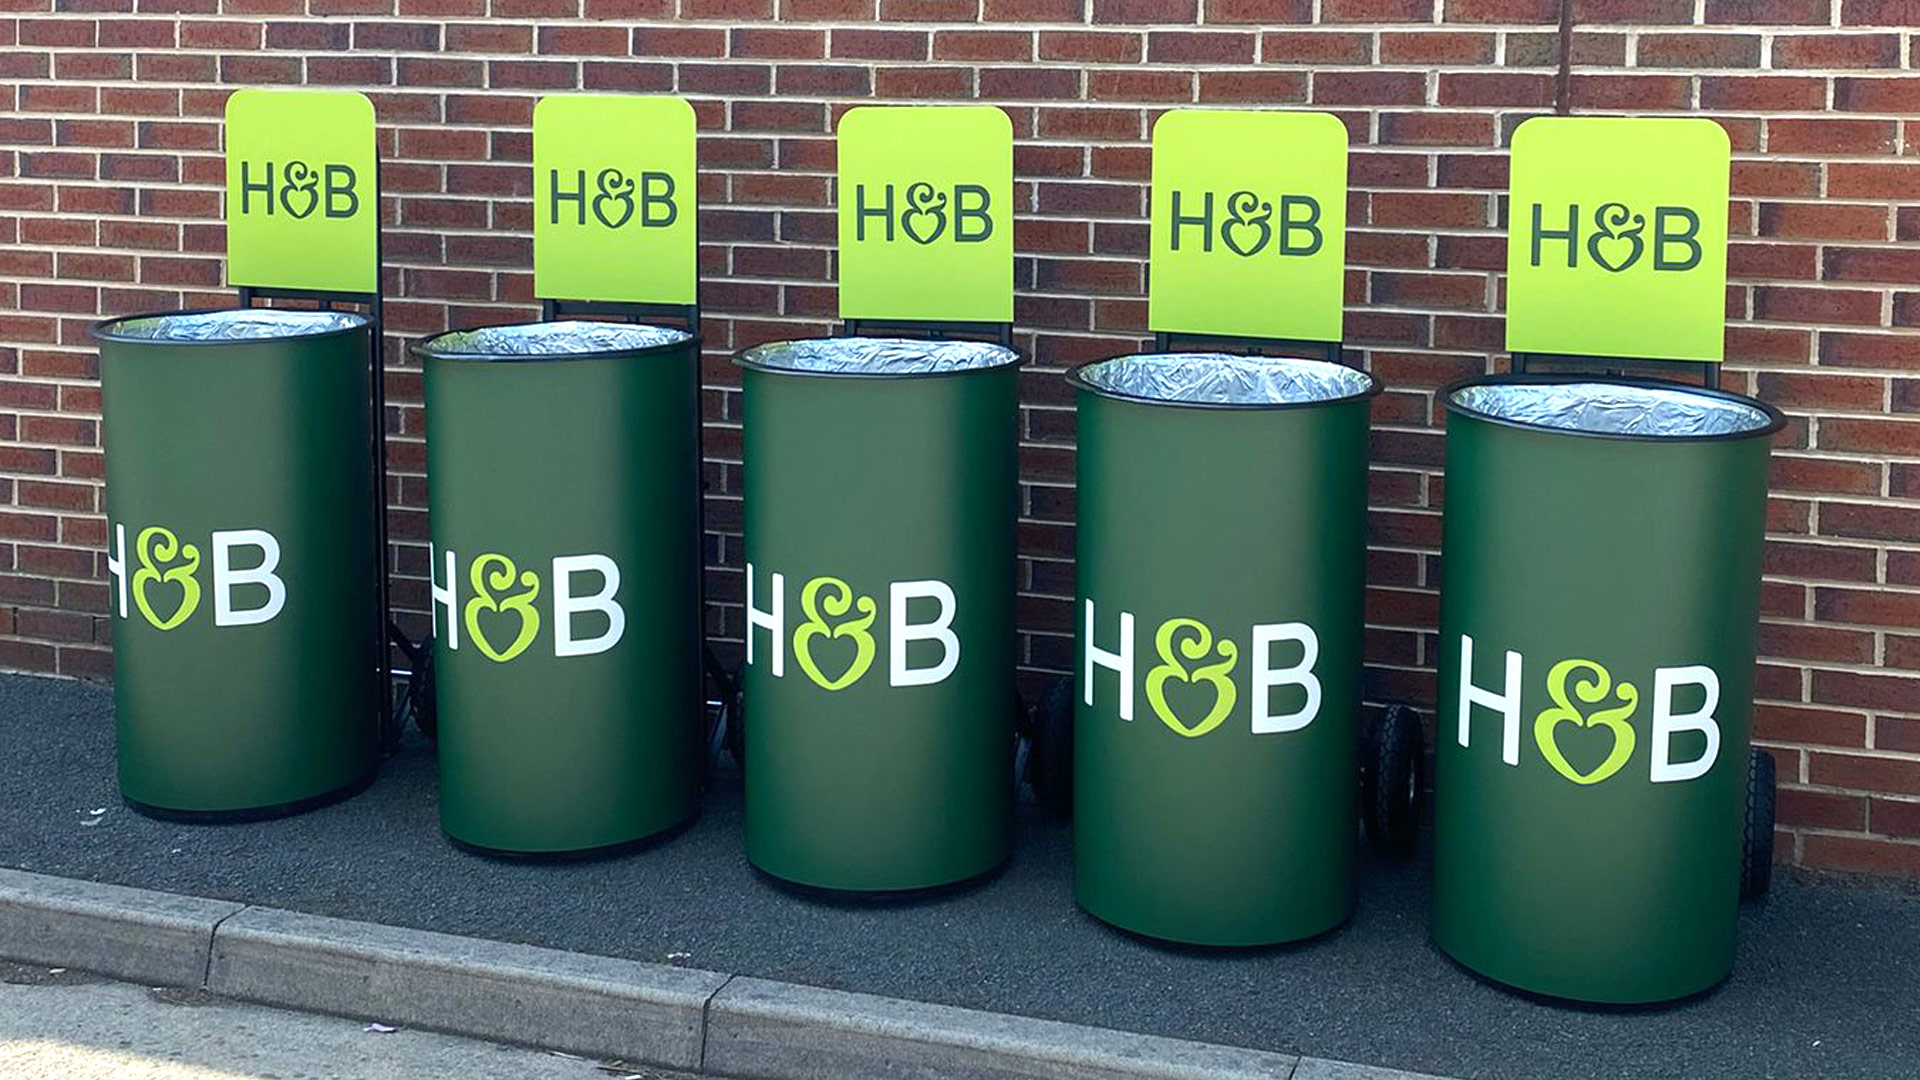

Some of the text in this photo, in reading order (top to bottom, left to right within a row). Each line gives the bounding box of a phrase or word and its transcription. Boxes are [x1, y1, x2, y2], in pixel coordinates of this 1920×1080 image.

[242, 161, 359, 219] H&B
[551, 169, 678, 229] H&B
[857, 183, 994, 245] H&B
[1171, 191, 1323, 257] H&B
[1531, 203, 1703, 272] H&B
[430, 542, 626, 662] H&B
[747, 563, 960, 691] H&B
[1085, 599, 1322, 738] H&B
[1459, 635, 1720, 785] H&B
